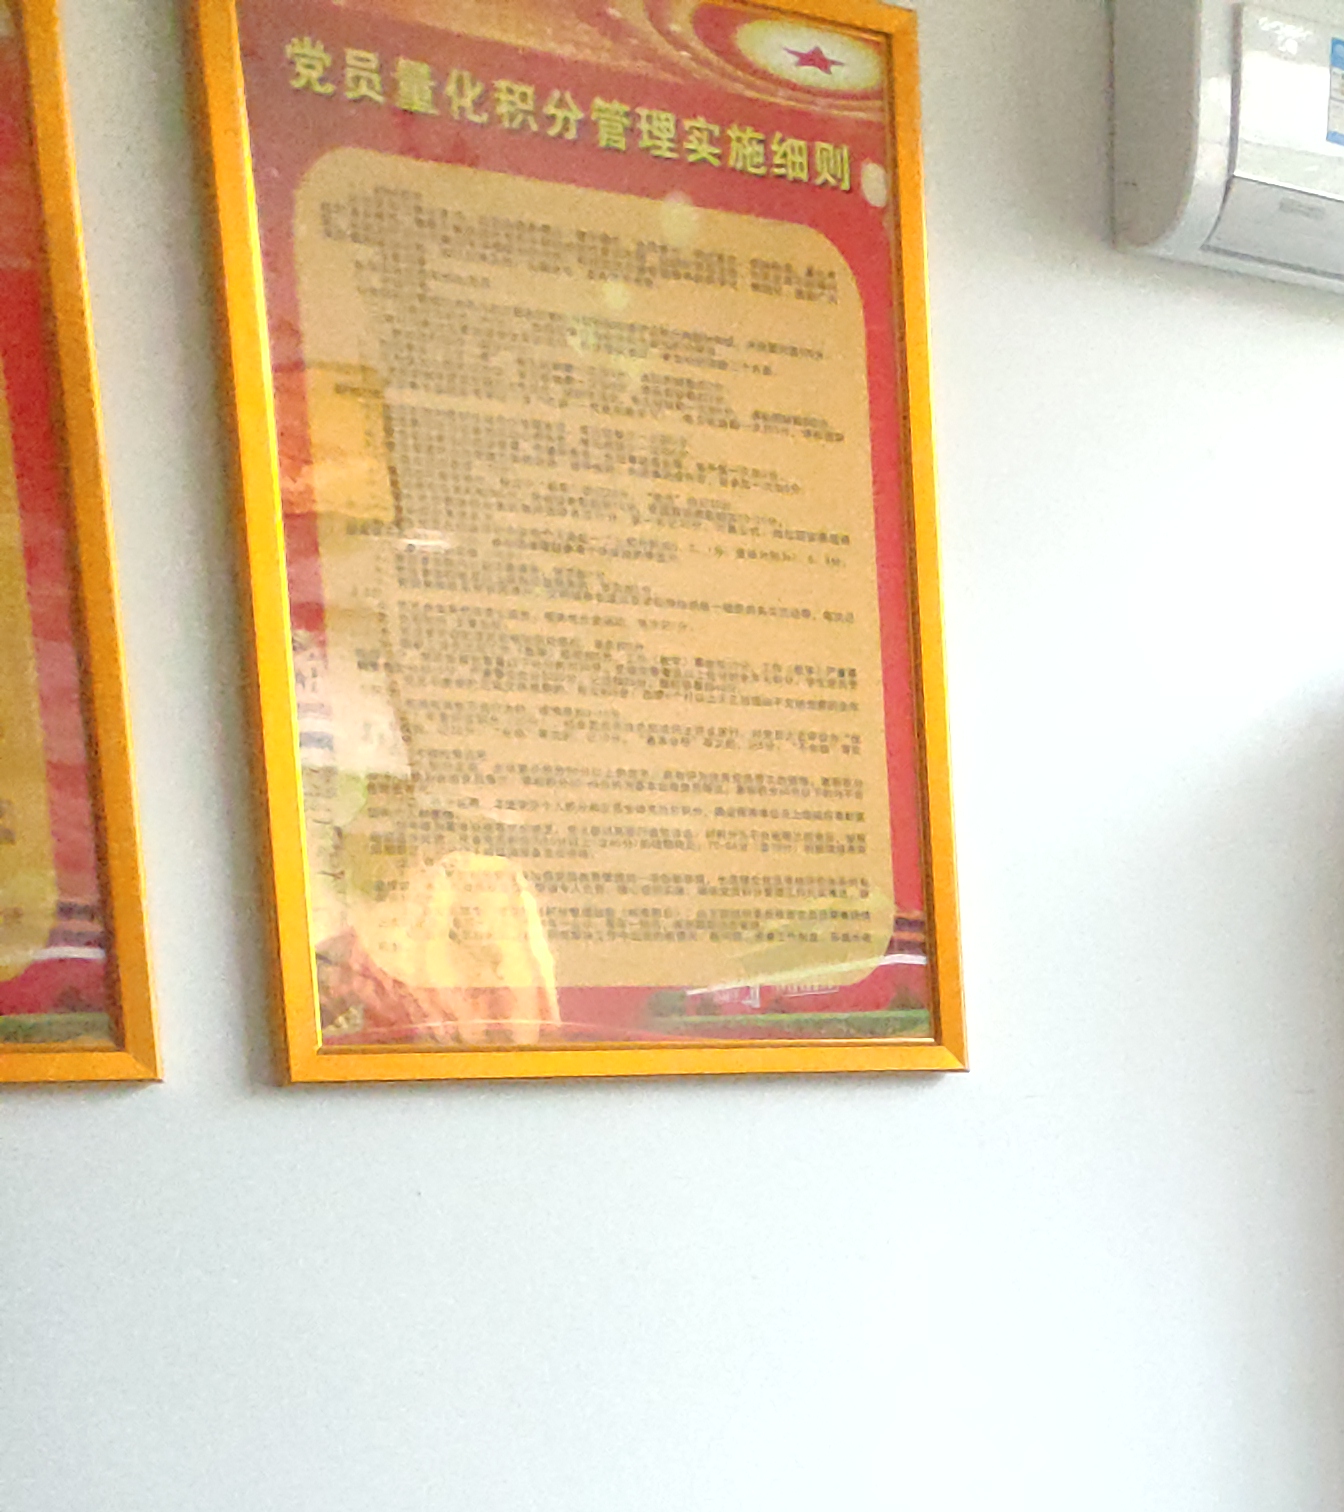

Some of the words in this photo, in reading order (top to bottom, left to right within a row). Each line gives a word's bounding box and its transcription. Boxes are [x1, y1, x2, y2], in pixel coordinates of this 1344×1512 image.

[285, 36, 852, 192] 党员量化积分管理实施细则
